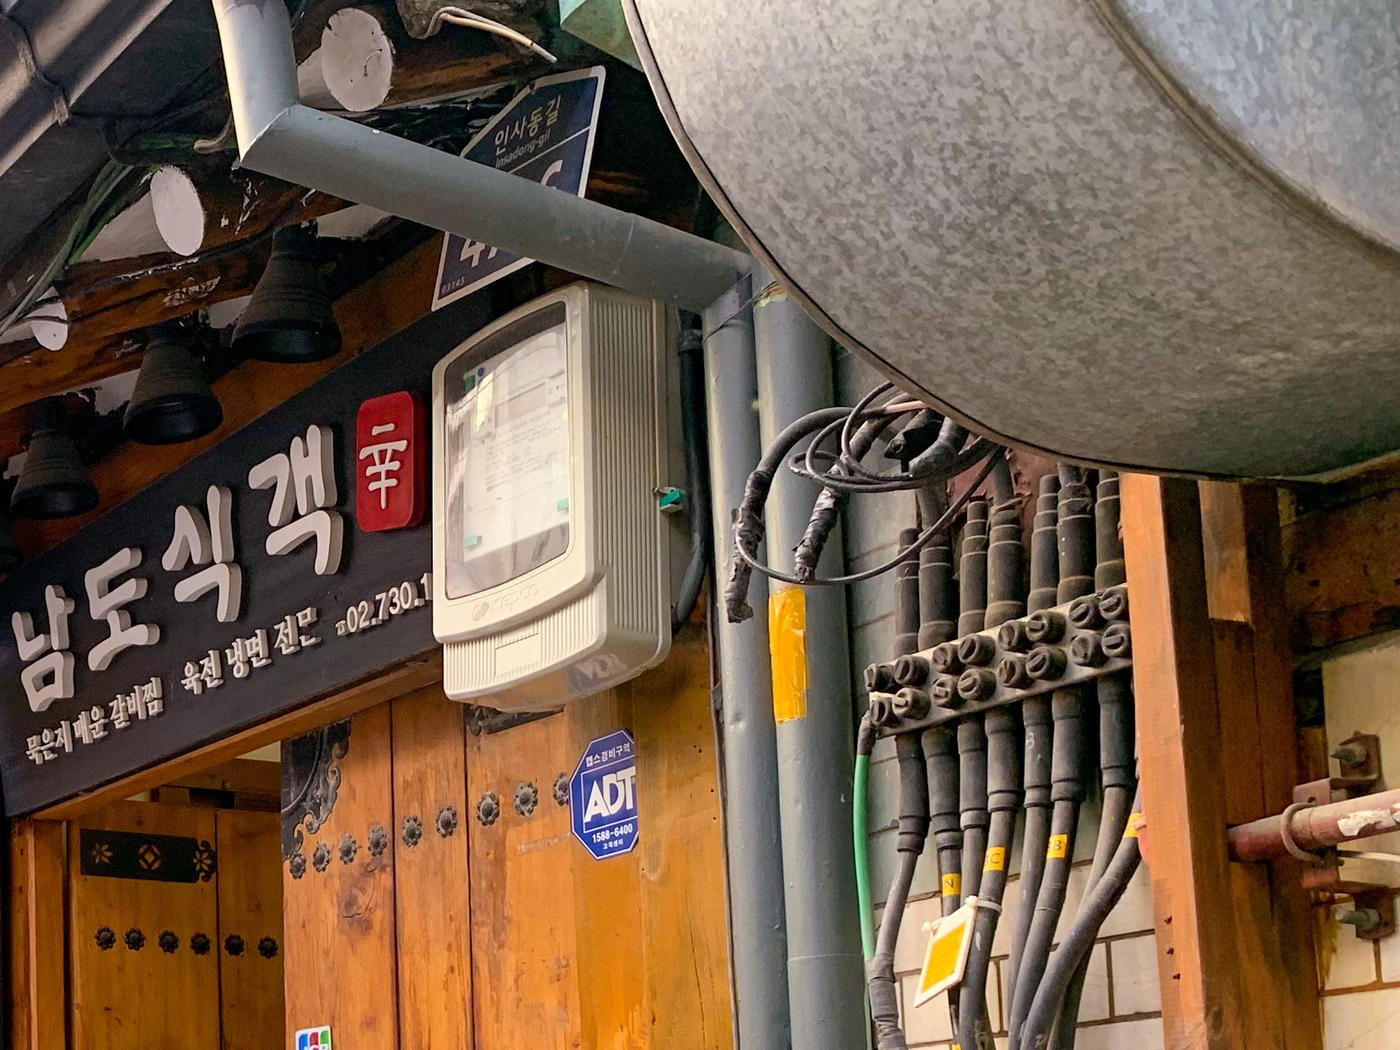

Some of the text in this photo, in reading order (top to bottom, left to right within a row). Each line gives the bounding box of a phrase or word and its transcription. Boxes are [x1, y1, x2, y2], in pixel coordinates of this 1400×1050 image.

[495, 94, 561, 158] 인사동길
[496, 128, 550, 168] Insadong-gil
[11, 424, 344, 712] 남도식객
[26, 721, 73, 765] 묵은지
[181, 649, 224, 695] 육전
[226, 629, 272, 679] 냉면
[274, 606, 322, 656] 전문
[346, 573, 432, 632] 02.730.1
[584, 766, 636, 823] ADT
[592, 823, 633, 843] 1588-6400
